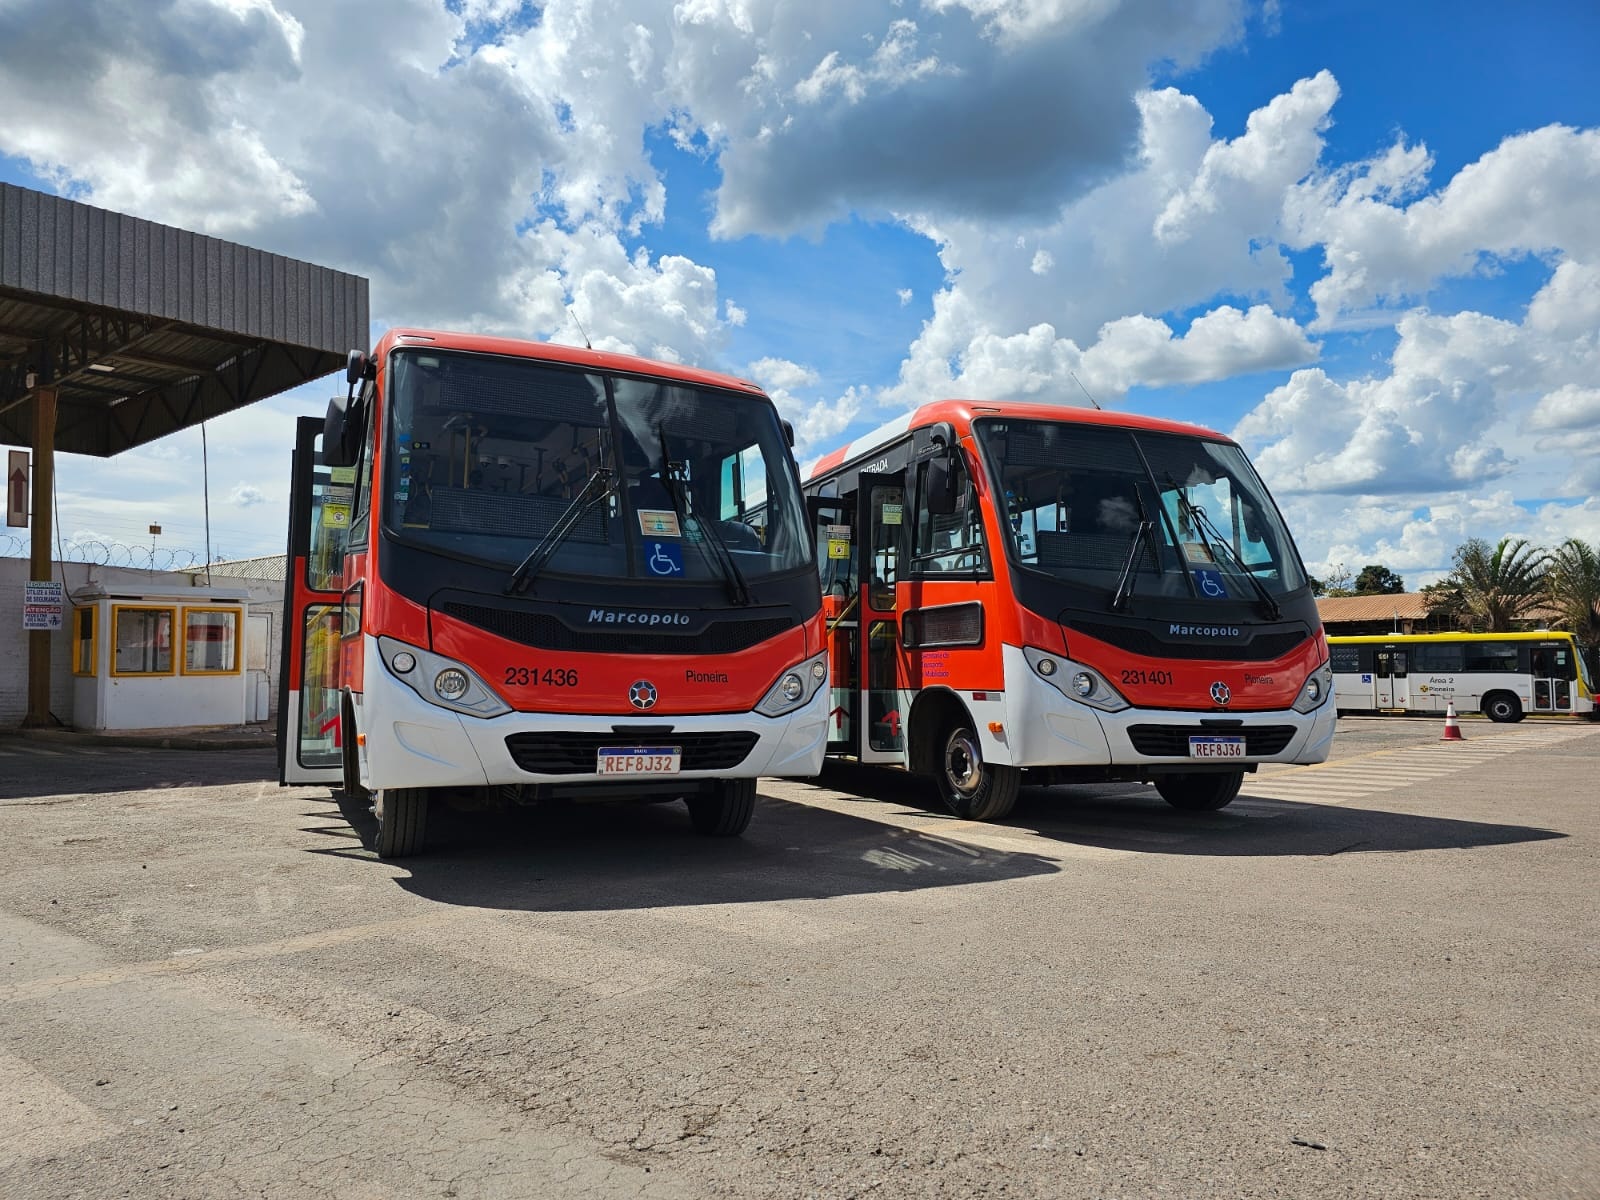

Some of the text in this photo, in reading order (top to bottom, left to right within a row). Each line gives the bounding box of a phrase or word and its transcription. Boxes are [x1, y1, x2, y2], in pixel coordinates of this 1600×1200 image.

[588, 609, 690, 626] Marcopolo
[1169, 624, 1240, 637] Marcopolo
[504, 667, 579, 687] 231436
[685, 670, 729, 683] Pioneira
[1121, 670, 1173, 686] 231401
[1244, 674, 1274, 685] Pioneira
[1430, 676, 1447, 684] Área
[1196, 743, 1241, 757] REF8J36
[605, 756, 673, 772] REF8J32
